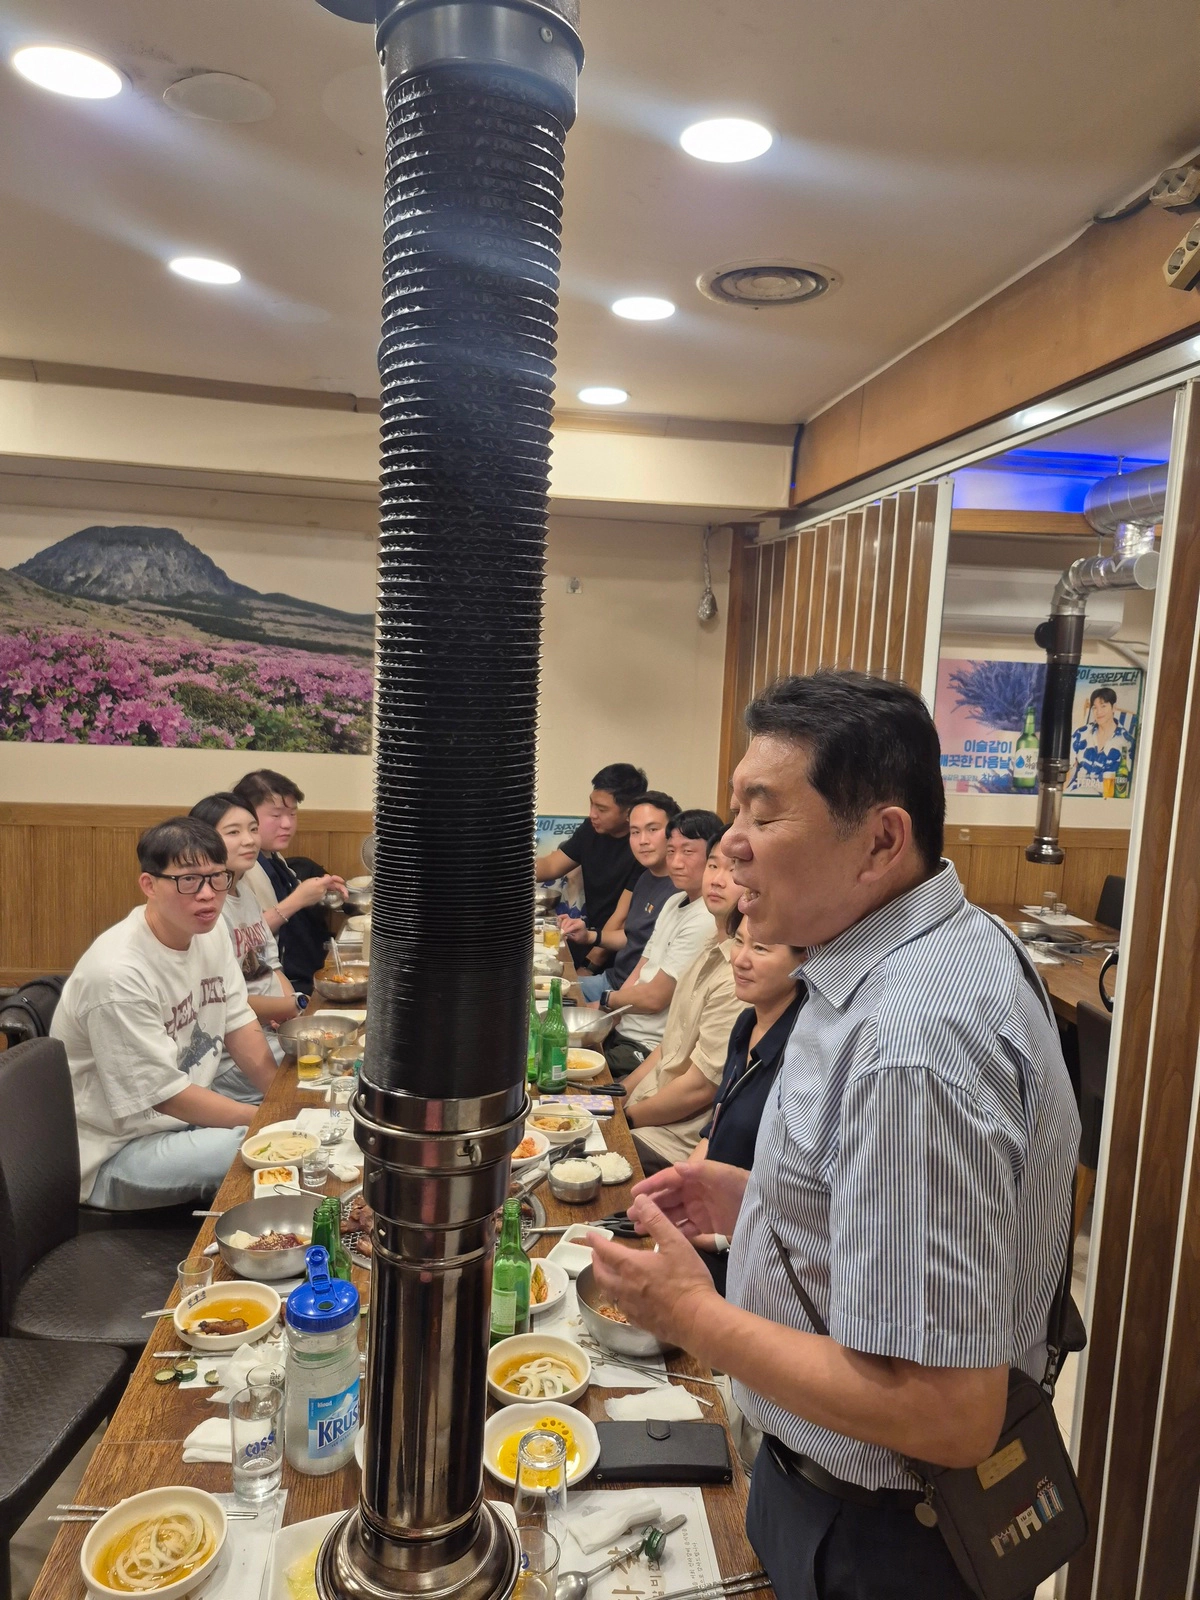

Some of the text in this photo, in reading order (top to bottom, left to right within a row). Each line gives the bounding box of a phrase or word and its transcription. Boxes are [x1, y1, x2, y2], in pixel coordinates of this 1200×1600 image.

[964, 739, 1012, 754] 이슬같이
[974, 755, 1012, 770] 다음날
[553, 822, 583, 835] 청정
